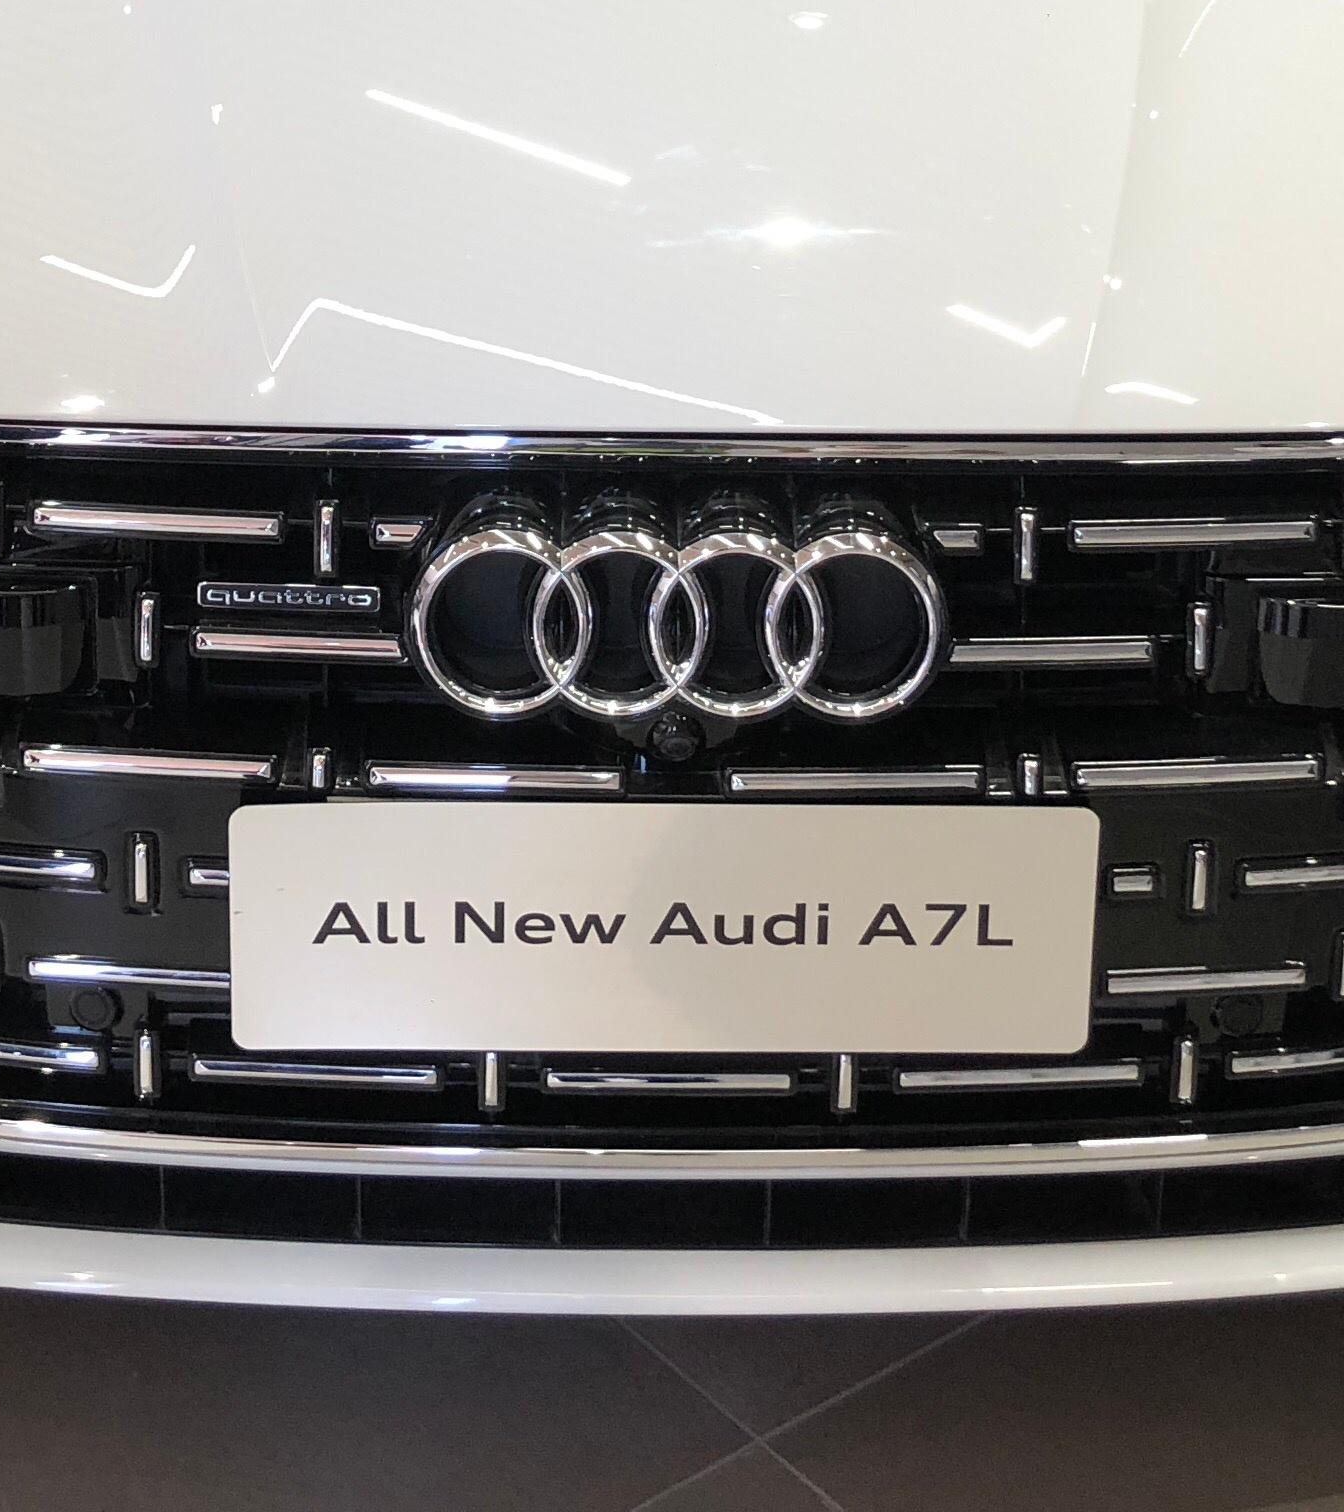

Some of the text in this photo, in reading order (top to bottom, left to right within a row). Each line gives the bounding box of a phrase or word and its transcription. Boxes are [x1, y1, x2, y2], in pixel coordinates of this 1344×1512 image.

[206, 588, 373, 607] quattro
[311, 899, 1014, 947] All New Audi A7L
